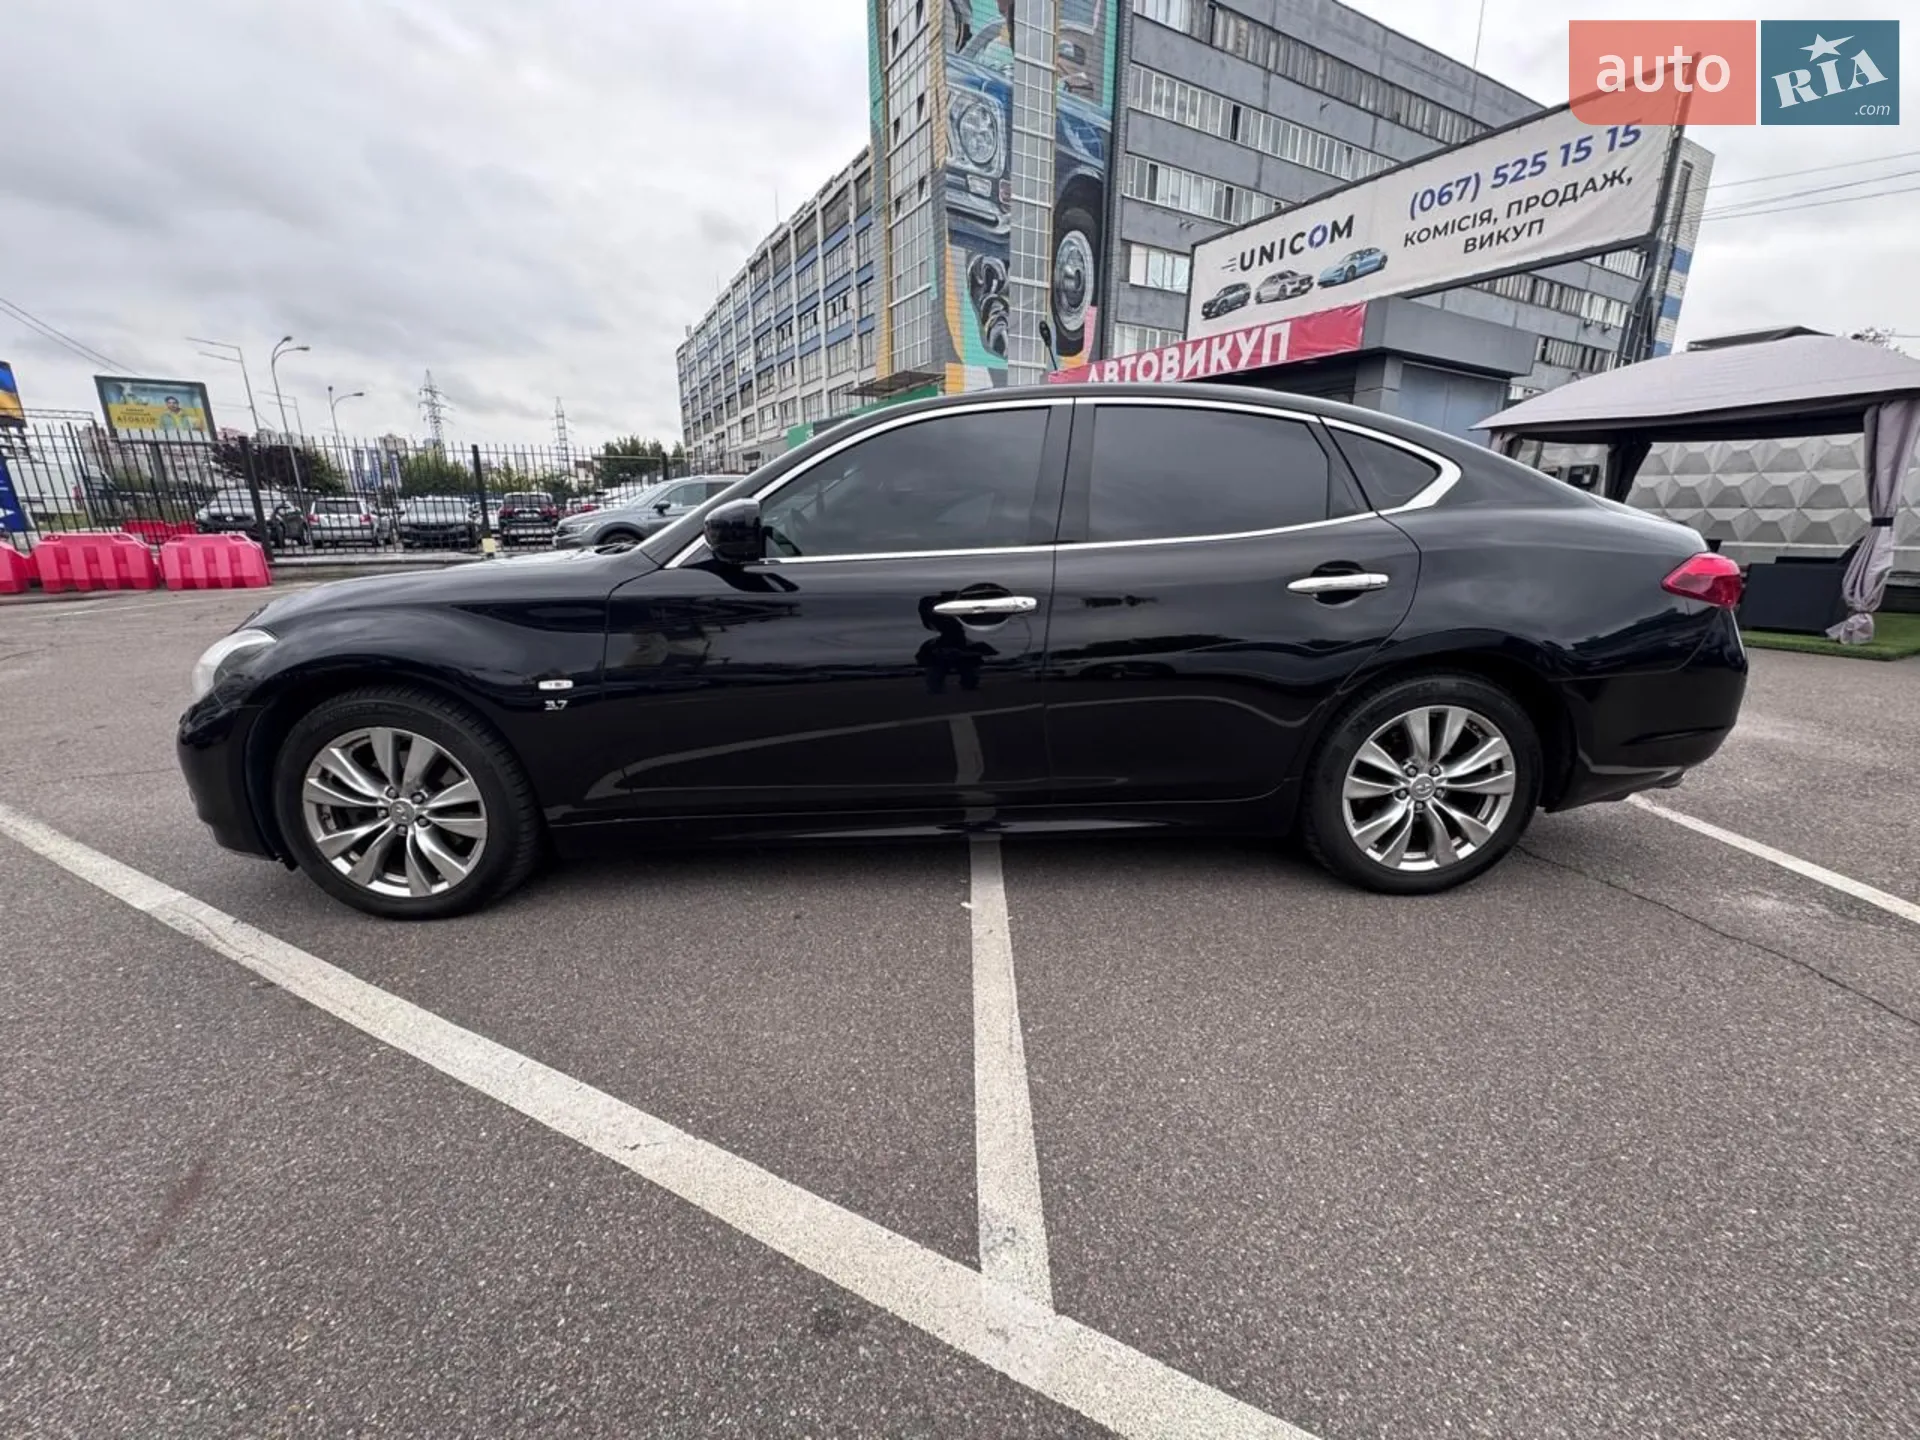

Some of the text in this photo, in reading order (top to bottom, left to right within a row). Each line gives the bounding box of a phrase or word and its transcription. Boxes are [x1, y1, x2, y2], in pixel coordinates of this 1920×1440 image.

[1409, 119, 1642, 220] (067) 525 15 15
[1404, 166, 1633, 247] КОМІСІЯ, ПРОДАЖ,
[1463, 218, 1544, 253] ВИКУП
[1239, 214, 1355, 272] UNICOM
[1087, 321, 1291, 383] АВТОВИКУП
